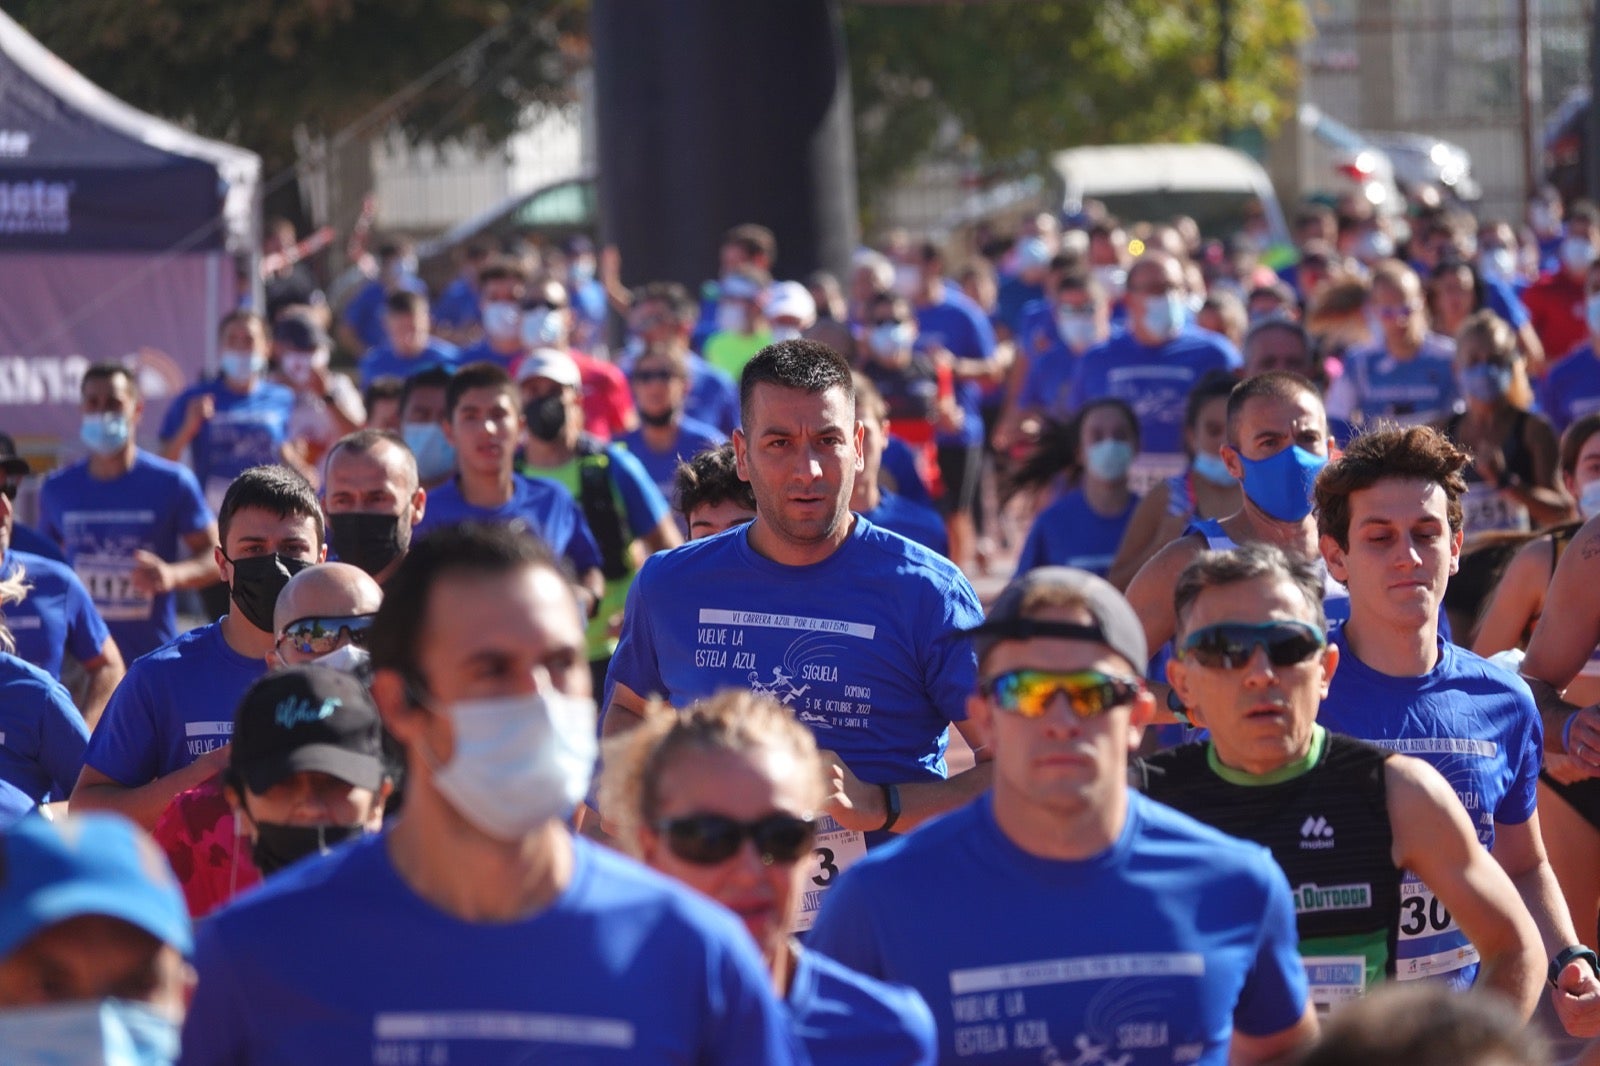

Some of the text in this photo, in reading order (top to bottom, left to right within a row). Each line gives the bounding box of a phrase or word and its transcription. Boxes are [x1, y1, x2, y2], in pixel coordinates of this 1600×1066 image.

[743, 613, 771, 625] CARRERA
[773, 616, 790, 626] AZUL
[794, 616, 806, 627] POR
[809, 619, 817, 628] EL
[820, 620, 850, 633] AUTISMO
[698, 628, 743, 646] VUELVE LA
[696, 649, 756, 670] ESTELA AZUL
[844, 684, 871, 700] DOMINGO
[805, 697, 811, 709] 3
[814, 698, 822, 711] DE
[825, 699, 853, 713] OCTUBRE
[844, 717, 861, 729] SANTA
